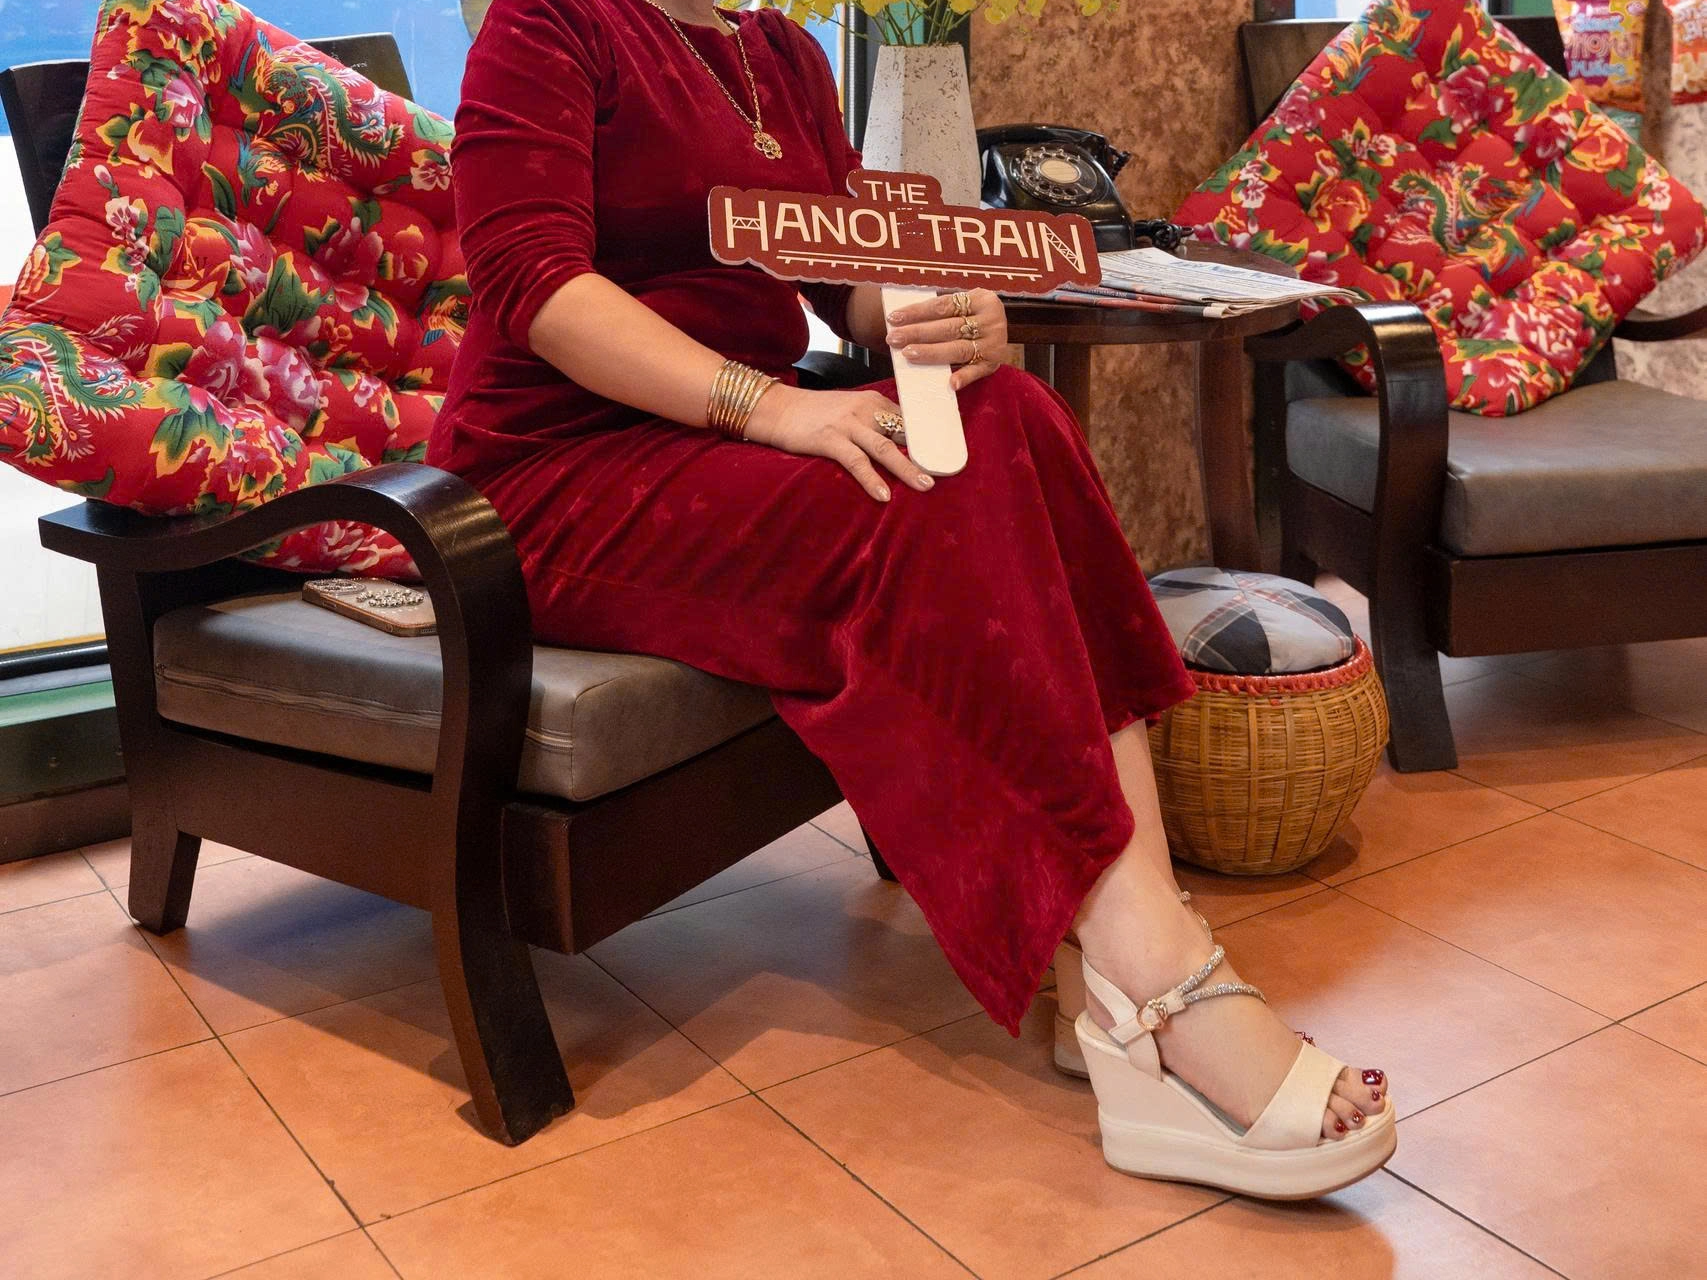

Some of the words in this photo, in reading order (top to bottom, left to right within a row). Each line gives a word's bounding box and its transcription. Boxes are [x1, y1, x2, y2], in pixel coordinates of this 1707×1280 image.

[862, 179, 929, 205] THE
[724, 197, 901, 252] HANOI
[917, 213, 1087, 274] TRAIN
